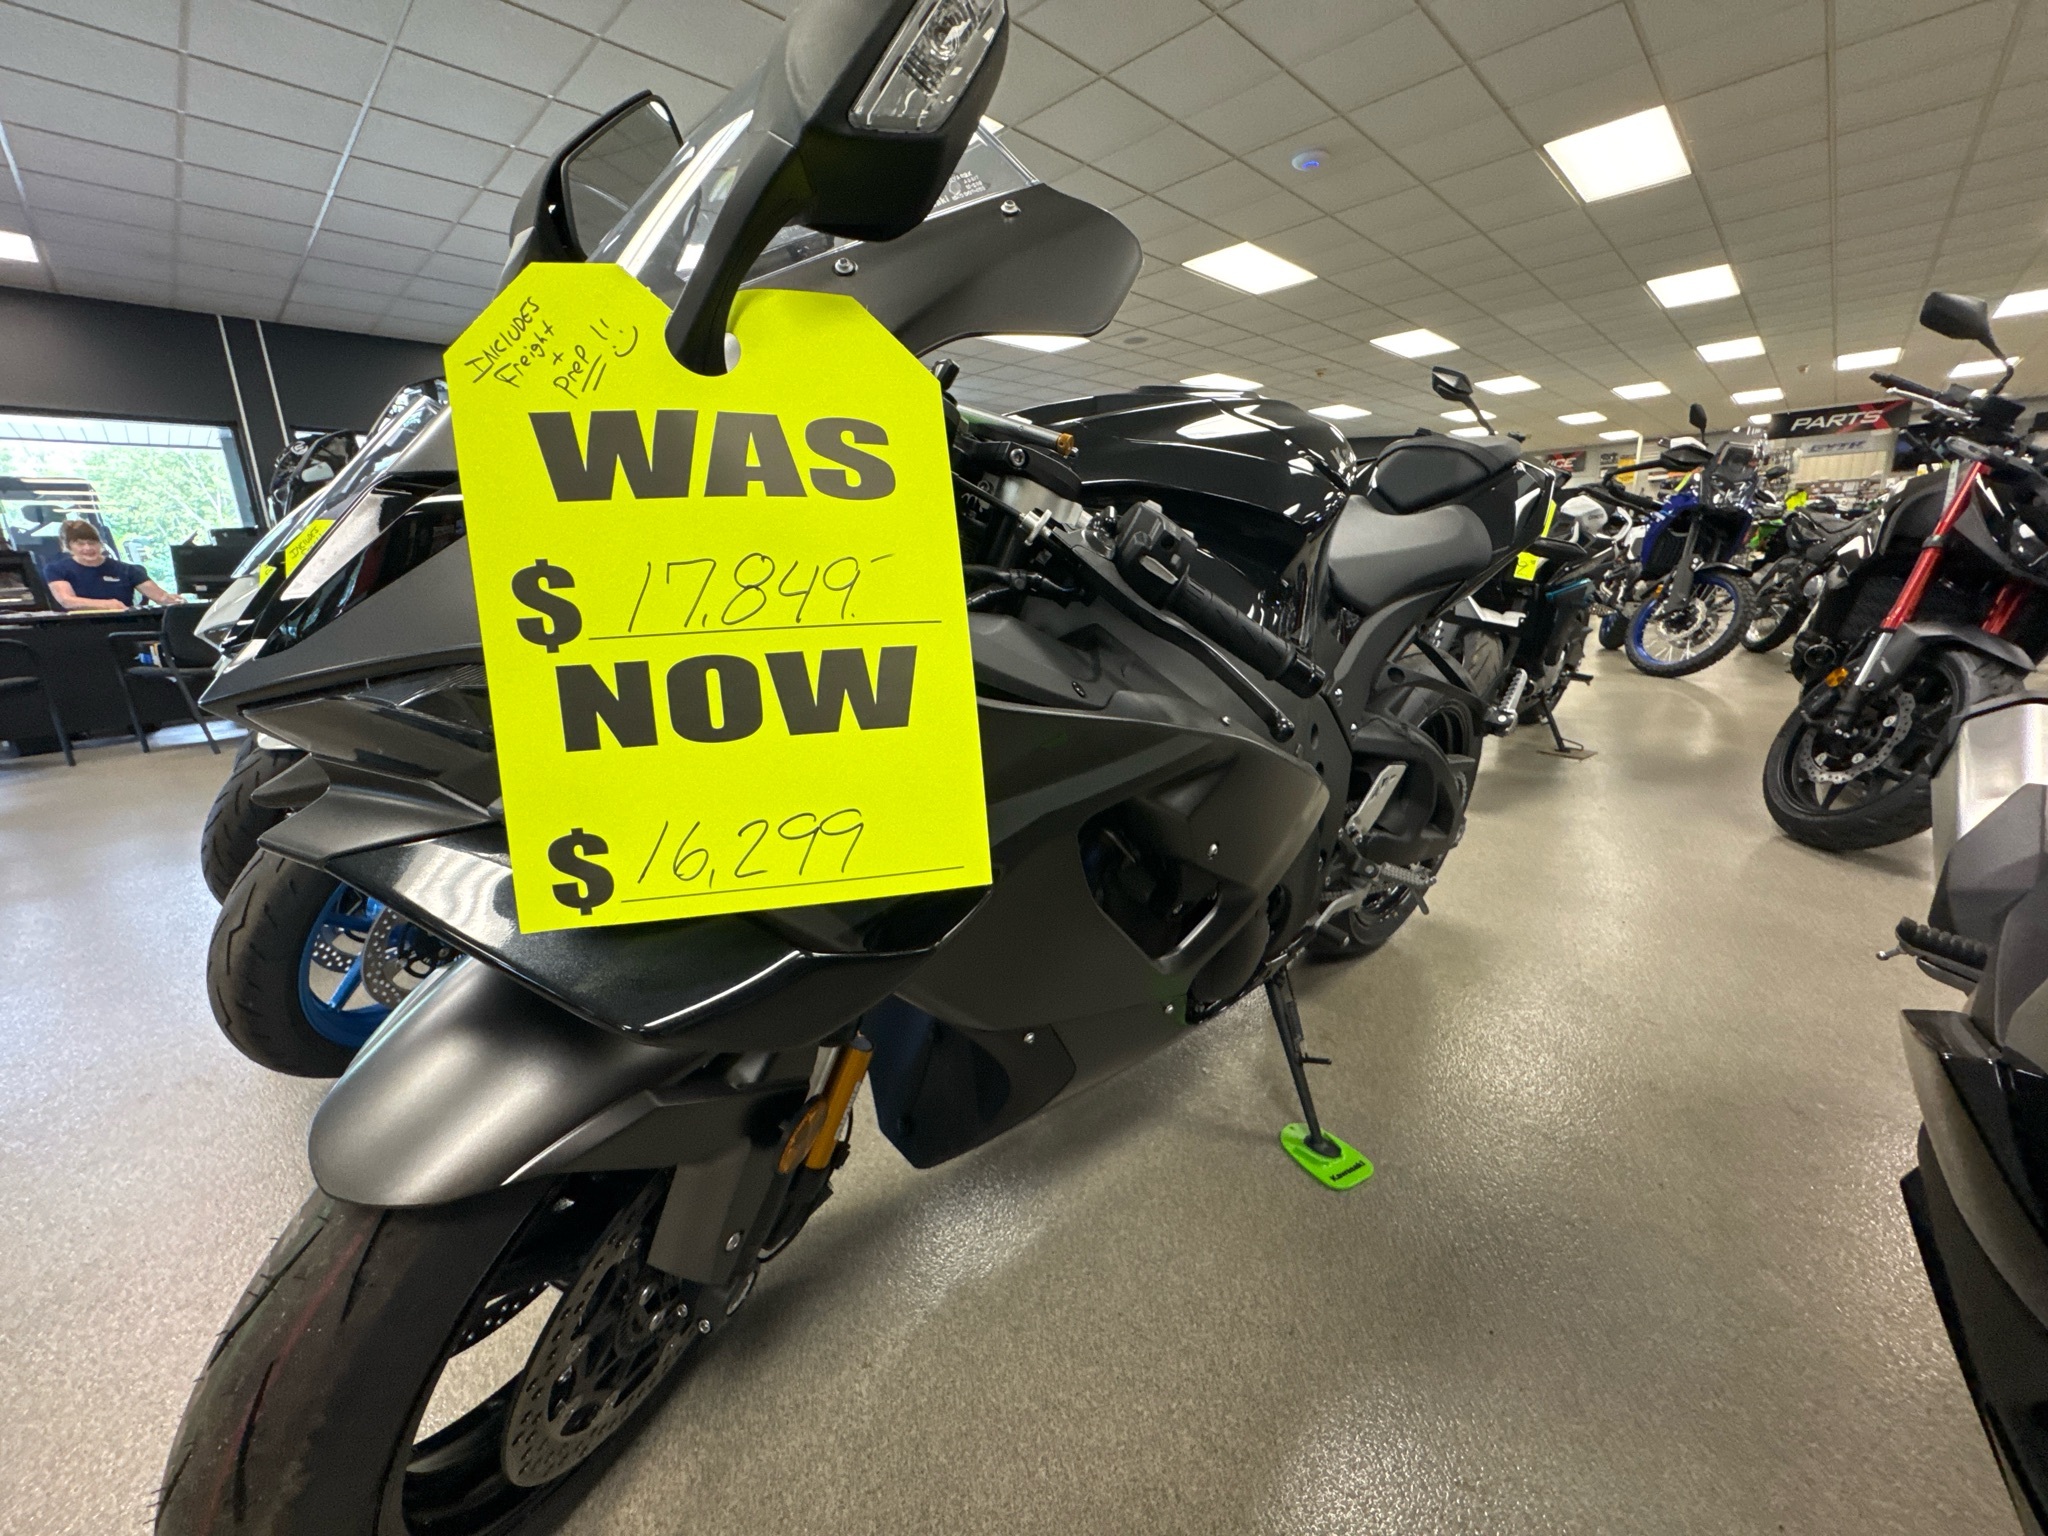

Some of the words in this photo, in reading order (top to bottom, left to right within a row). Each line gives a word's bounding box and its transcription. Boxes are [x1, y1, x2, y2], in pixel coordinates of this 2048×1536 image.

[465, 296, 540, 383] INCLUDES
[528, 410, 895, 502] WAS
[1790, 410, 1882, 431] PARTS
[511, 559, 583, 653] $
[555, 645, 917, 752] NOW
[547, 828, 615, 915] $
[637, 808, 864, 889] 16,299
